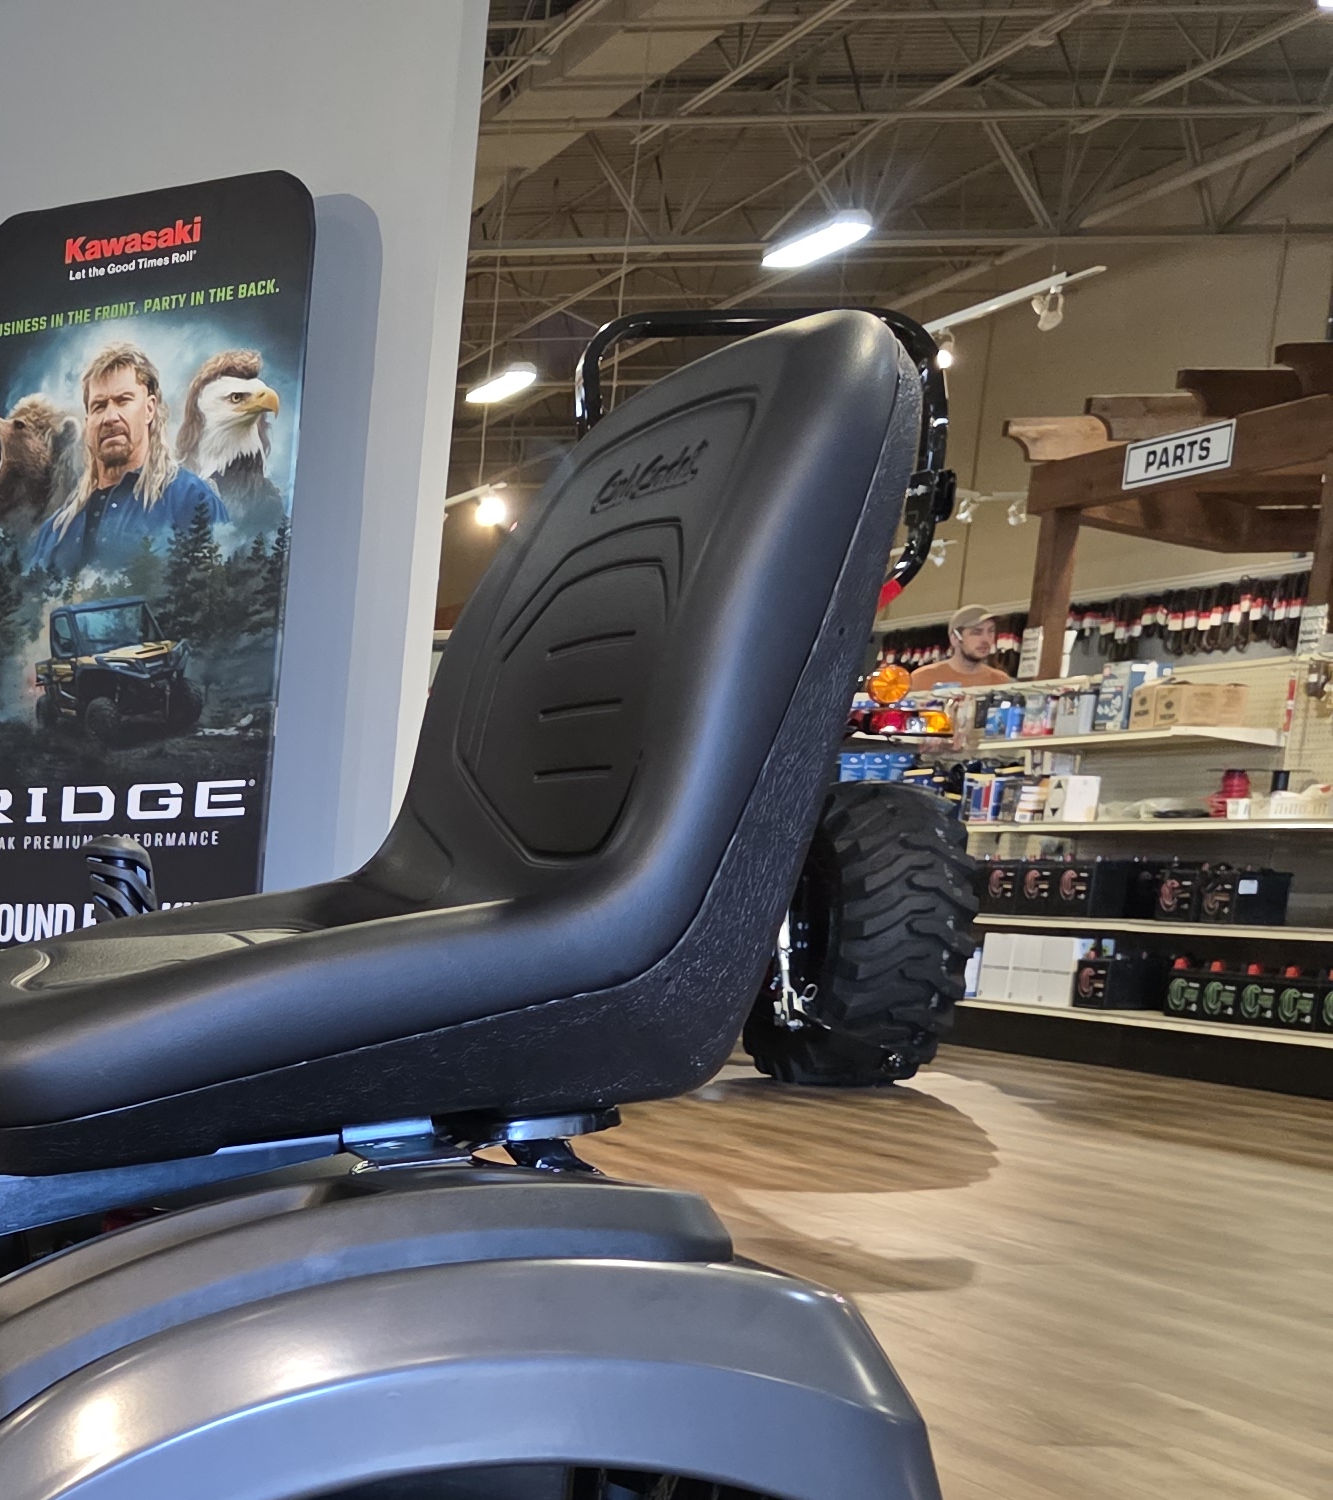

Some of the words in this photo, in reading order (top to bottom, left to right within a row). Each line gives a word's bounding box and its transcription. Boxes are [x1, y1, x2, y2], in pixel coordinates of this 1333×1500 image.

[64, 216, 203, 264] Kawasaki
[69, 268, 86, 281] Let
[88, 265, 106, 278] the
[107, 260, 135, 275] Good
[137, 255, 170, 270] Times
[171, 250, 194, 265] Roll
[51, 313, 64, 328] IN
[67, 308, 91, 325] THE
[94, 301, 140, 321] FRONT.
[143, 292, 187, 313] PARTY
[190, 290, 204, 306] IN
[208, 285, 235, 303] THE
[237, 278, 280, 299] BACK.
[1144, 436, 1211, 473] PARTS
[23, 834, 93, 850] PREMIUM
[103, 831, 219, 848] FORMANCE
